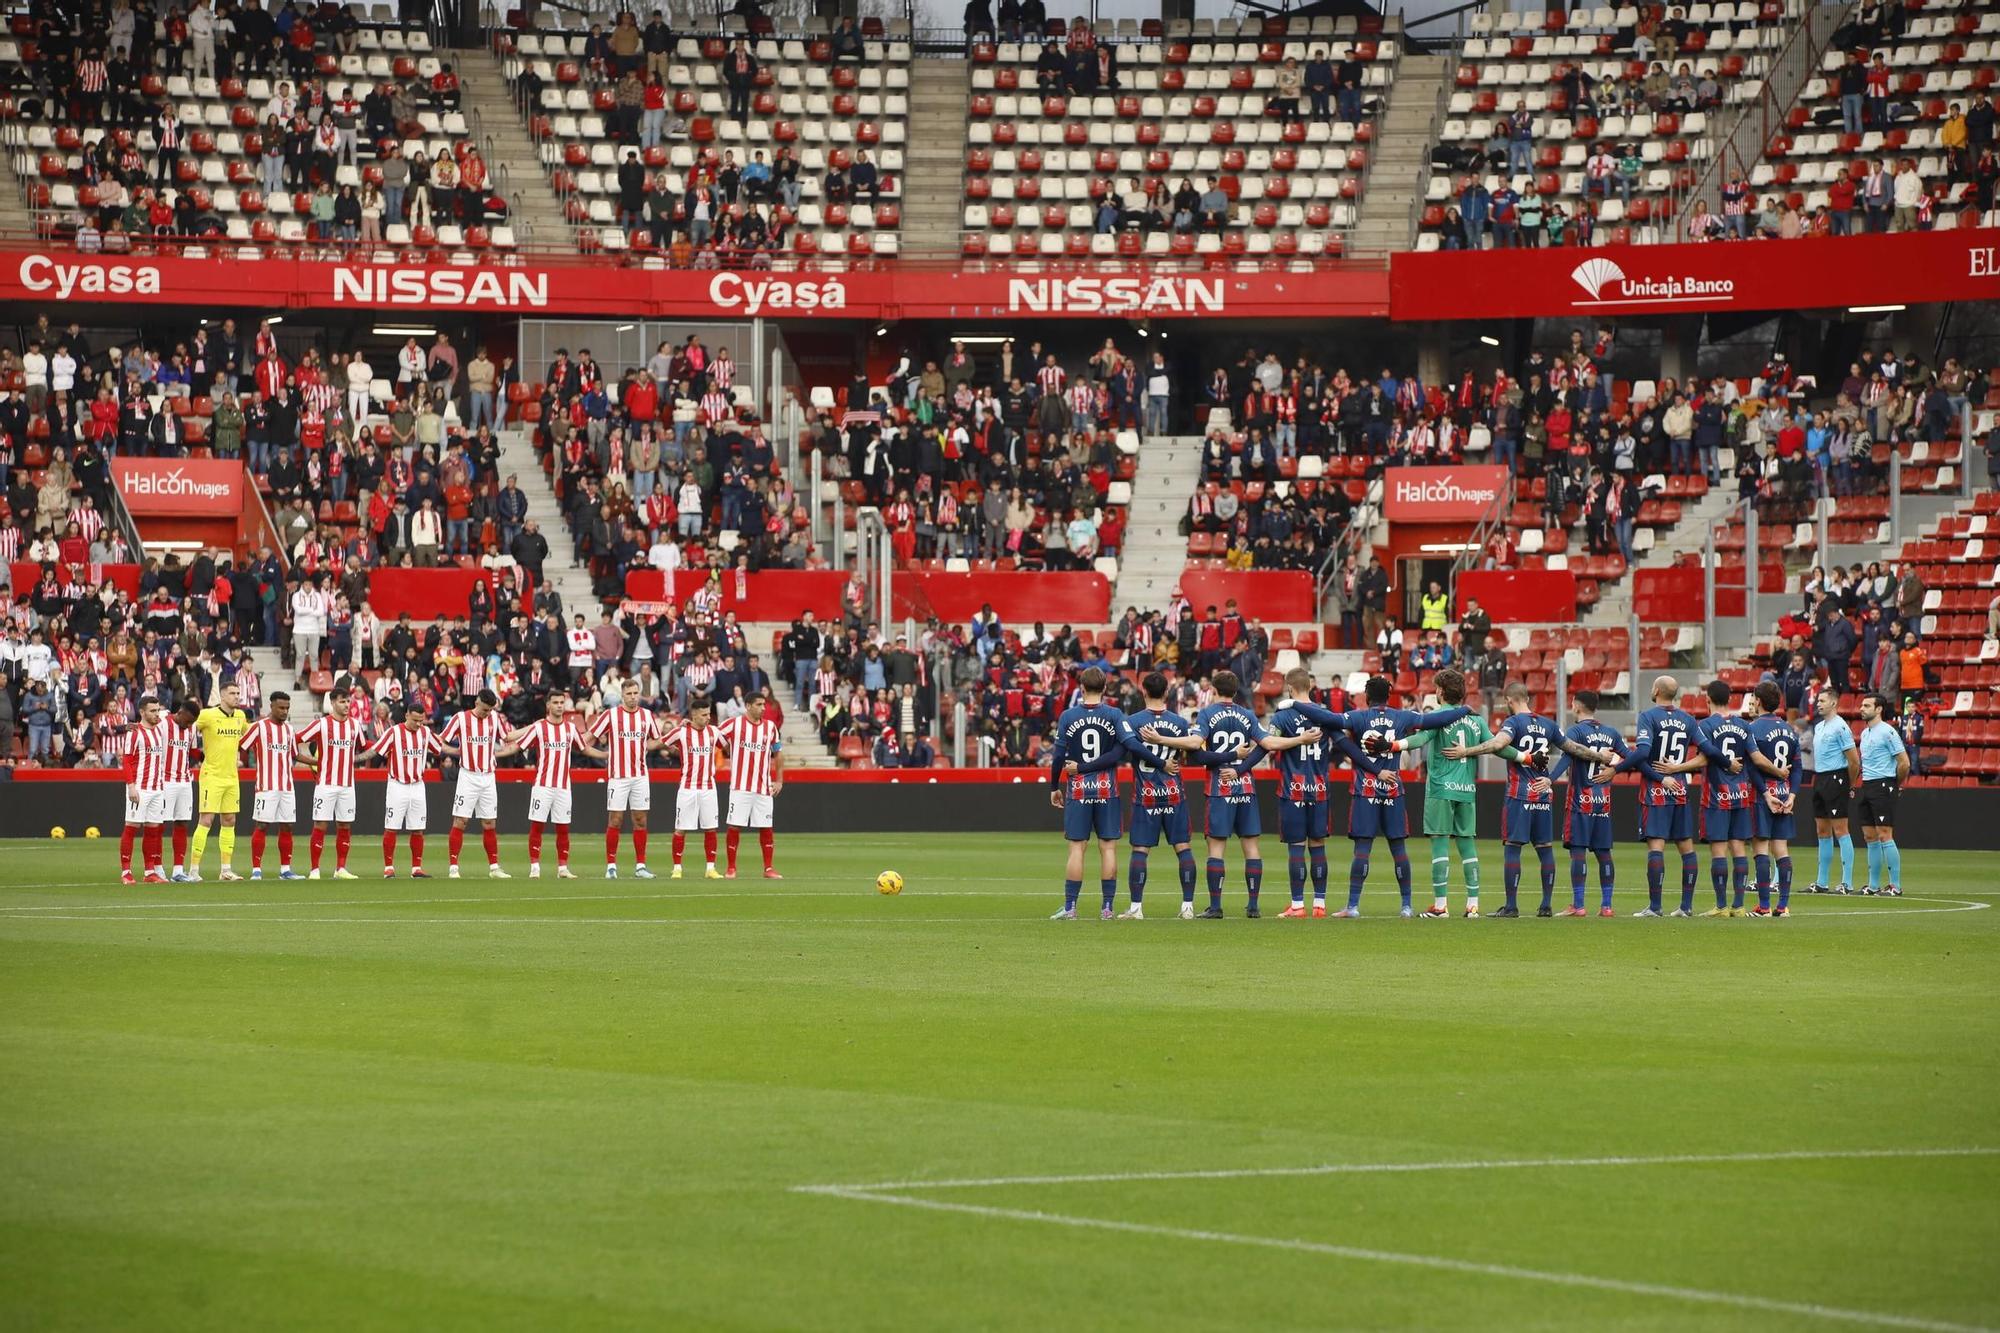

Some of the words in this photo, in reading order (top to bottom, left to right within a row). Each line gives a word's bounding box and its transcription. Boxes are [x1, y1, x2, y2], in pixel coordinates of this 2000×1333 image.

[19, 255, 160, 298] Cyasa
[333, 267, 548, 307] NISSAN
[1621, 276, 1682, 299] Unicaja
[1685, 277, 1733, 295] Banco
[709, 272, 846, 314] Cyasa
[1008, 278, 1224, 312] NISSAN
[1066, 718, 1086, 738] HUGO
[1086, 716, 1116, 737] VALLEJO
[1208, 709, 1251, 731] KORTAJARENA
[1660, 718, 1687, 731] BLASCO
[619, 731, 646, 739] JALISCO
[1081, 728, 1101, 763] 9
[1212, 731, 1246, 765] 22
[1456, 729, 1467, 764] 1
[1658, 731, 1687, 765] 15
[1765, 728, 1781, 742] JAVI
[1773, 740, 1789, 770] 8
[1071, 780, 1112, 790] SOMMOS
[1141, 785, 1180, 797] SOMMOS
[1289, 782, 1327, 792] SOMMOS
